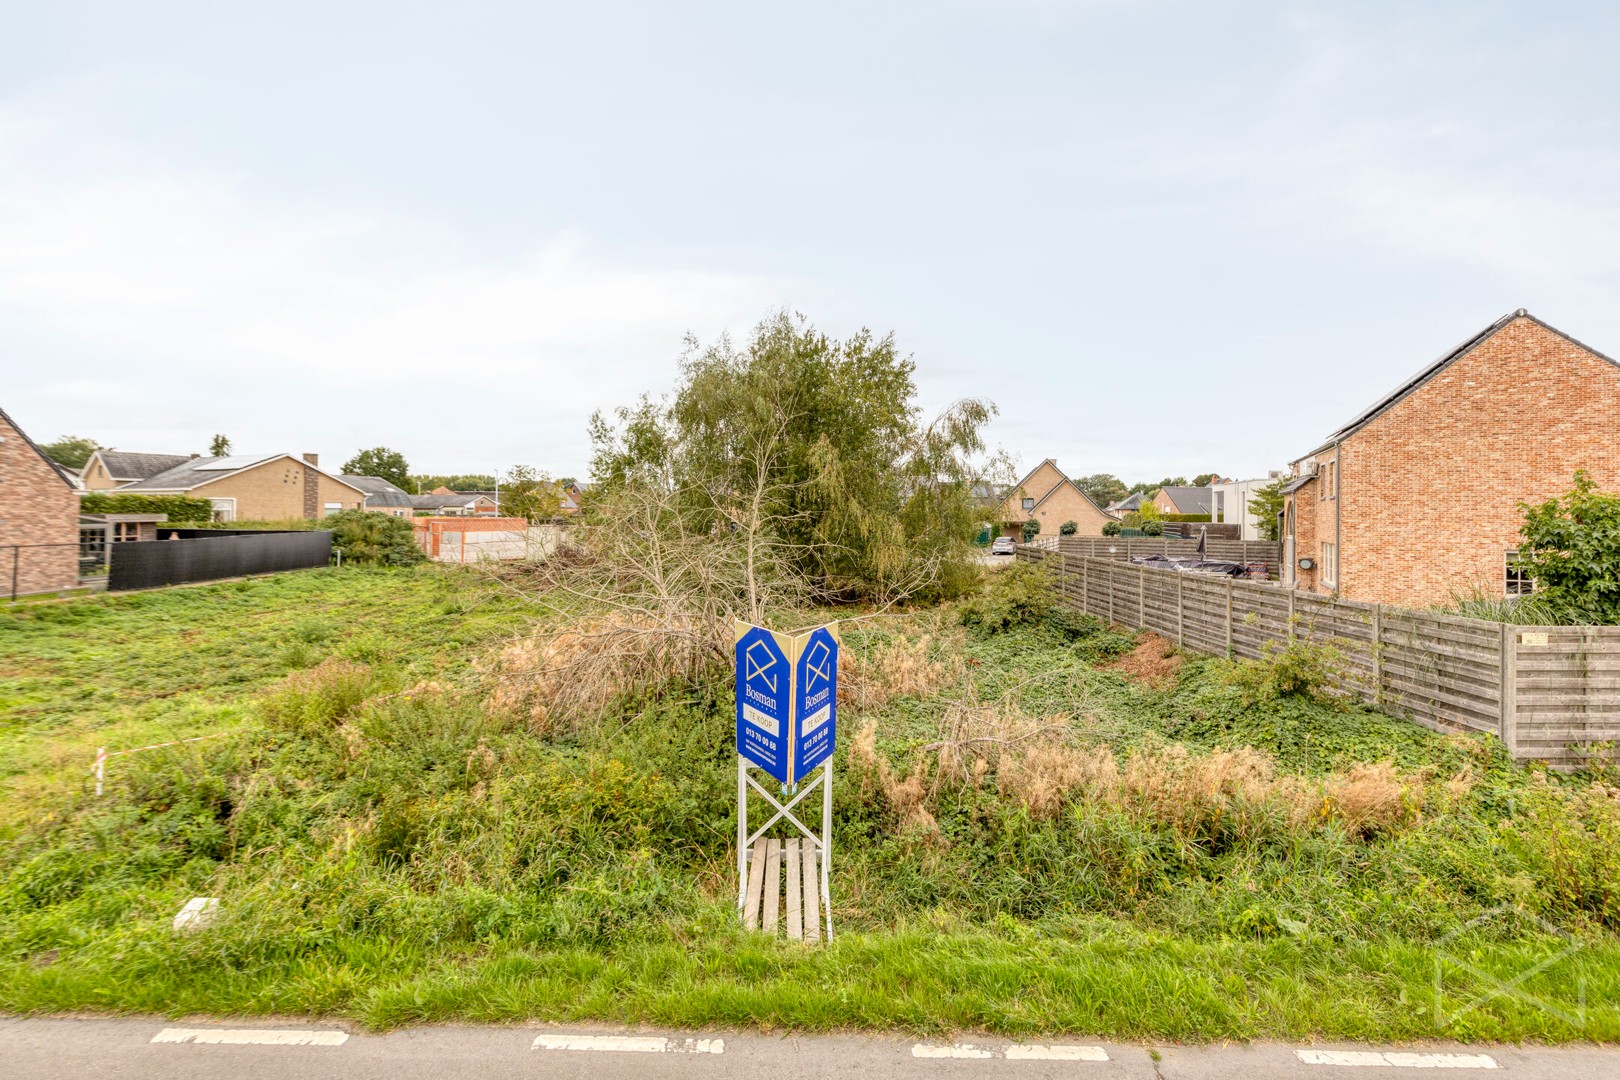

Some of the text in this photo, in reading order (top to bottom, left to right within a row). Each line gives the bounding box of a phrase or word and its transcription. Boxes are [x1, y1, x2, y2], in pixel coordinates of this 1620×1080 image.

[746, 683, 776, 710] Bosman
[805, 687, 829, 710] Bosman
[749, 711, 772, 728] TE KOOP
[808, 711, 826, 729] TE KOOP
[746, 727, 755, 738] 013
[755, 732, 762, 742] 70
[804, 739, 812, 751] 013
[812, 735, 818, 745] 70
